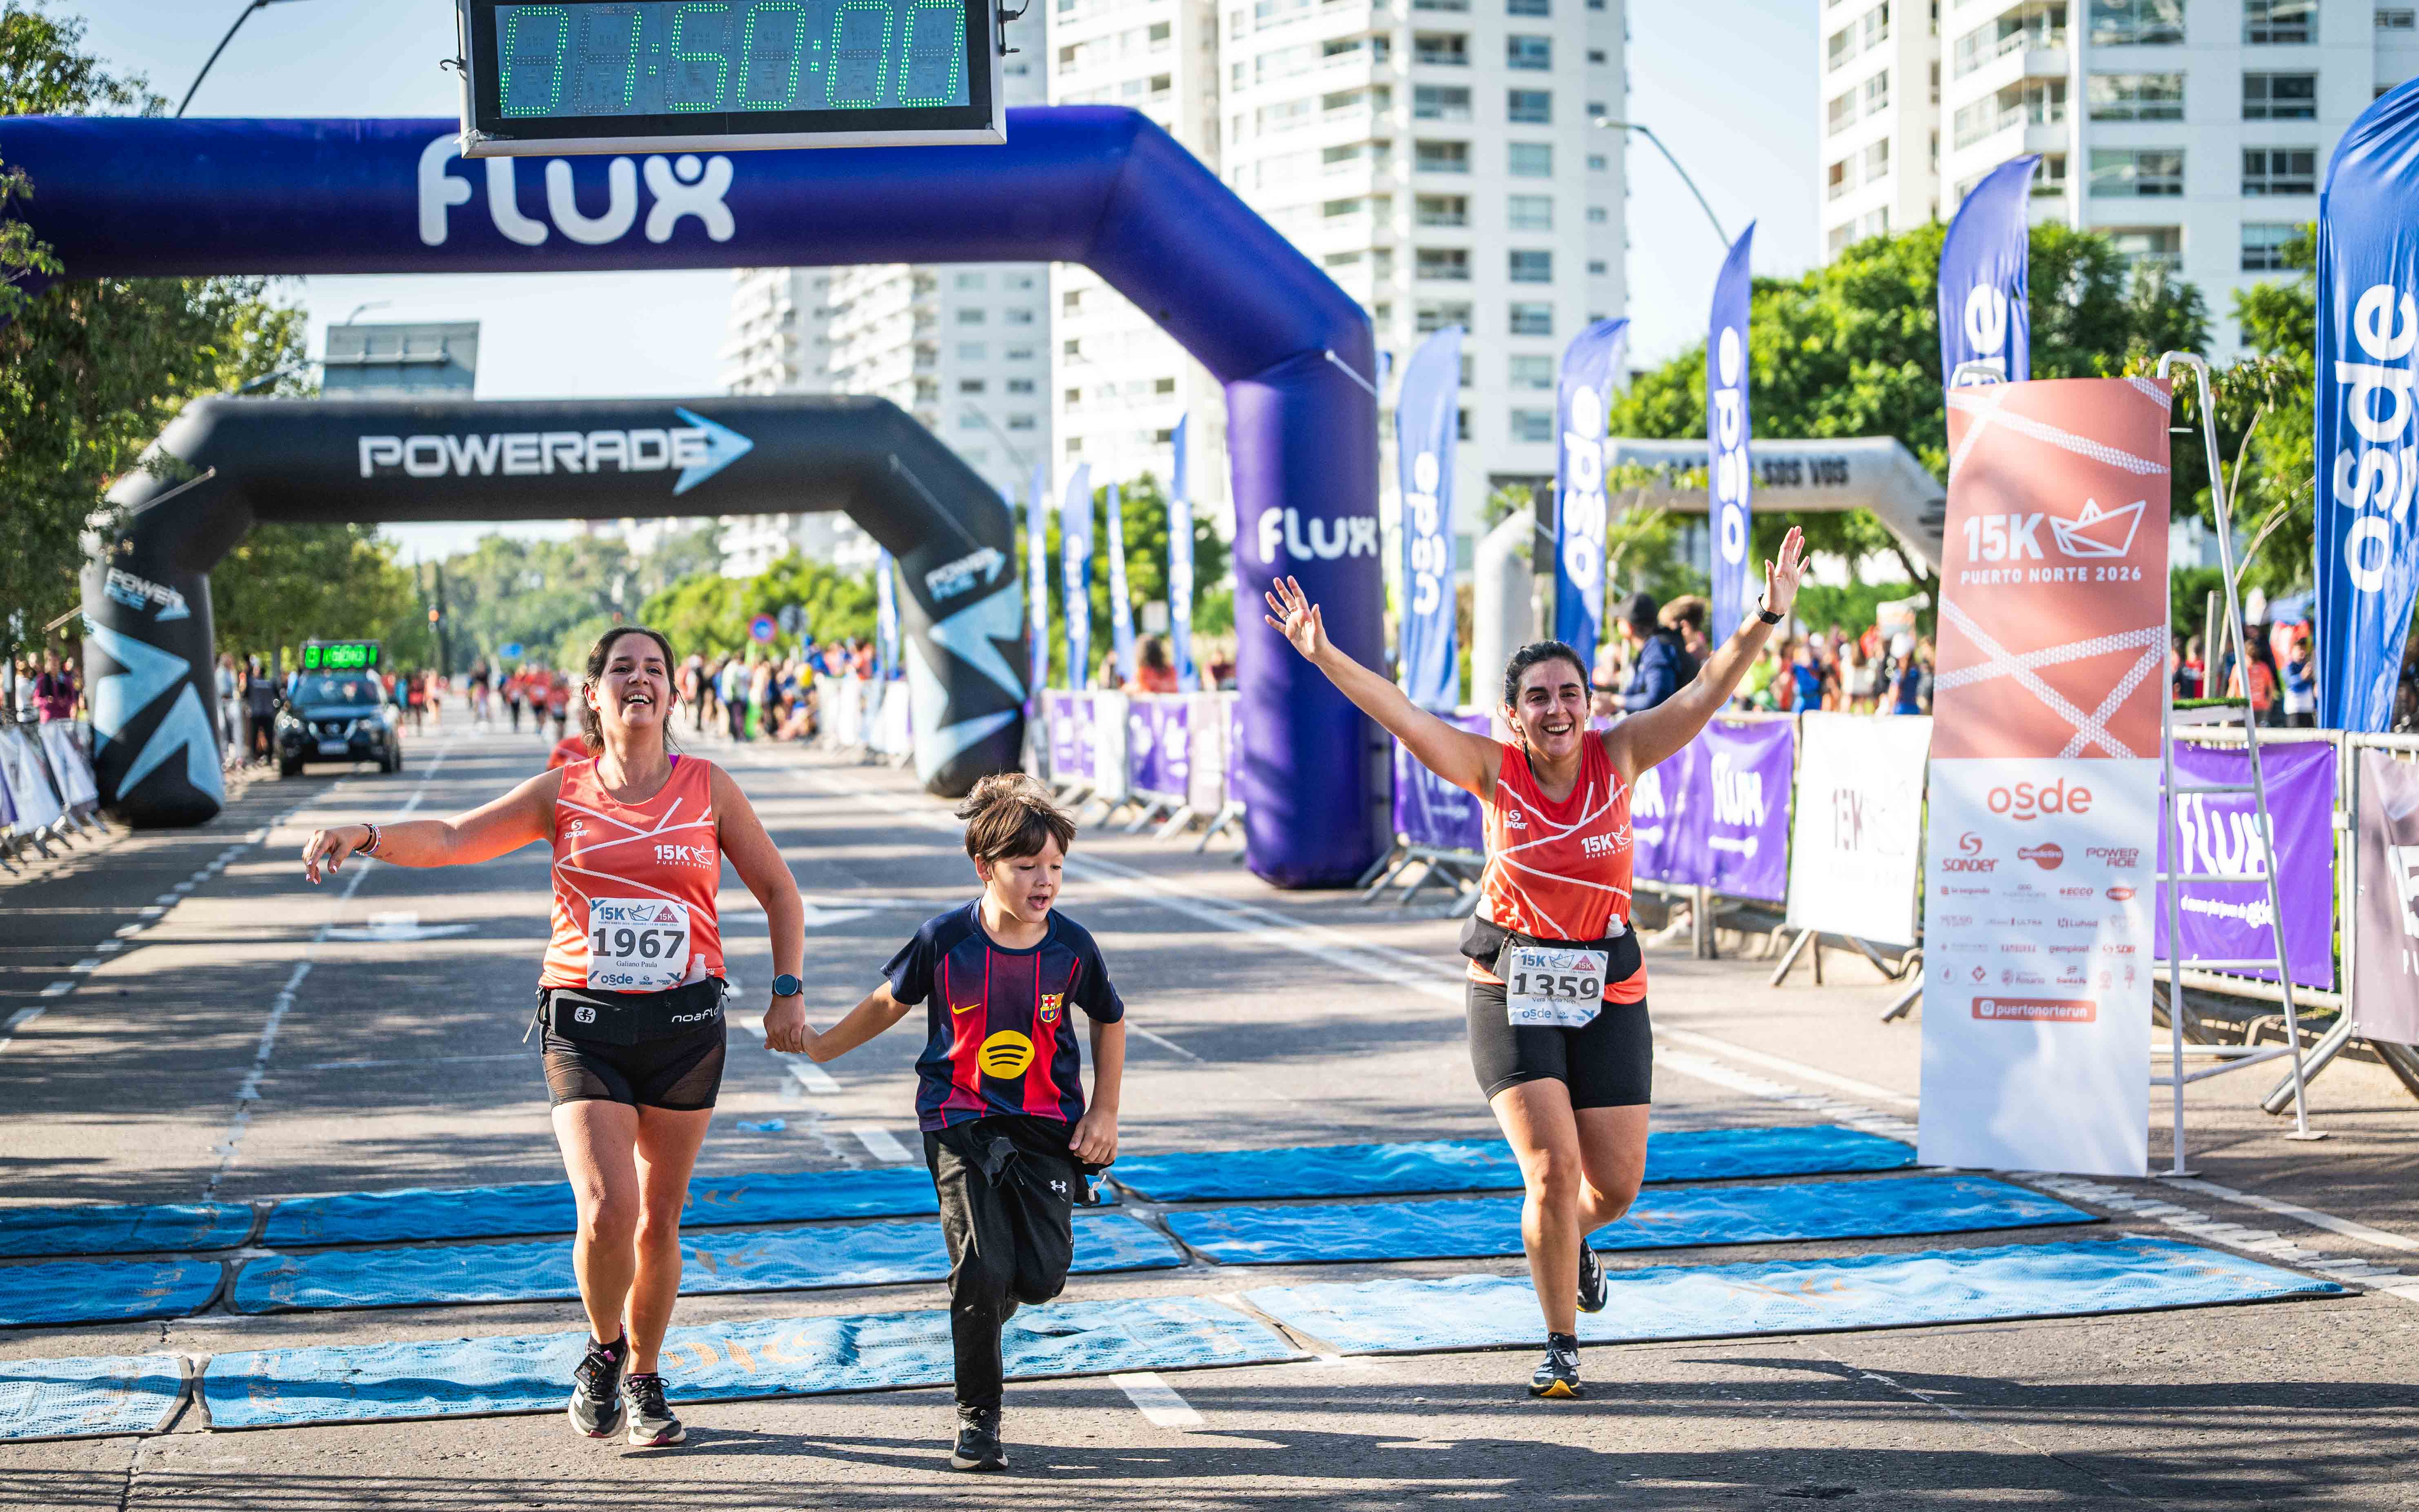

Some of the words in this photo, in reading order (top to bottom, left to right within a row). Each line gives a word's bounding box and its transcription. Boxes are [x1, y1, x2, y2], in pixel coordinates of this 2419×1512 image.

[1715, 326, 1748, 566] osde
[2333, 284, 2418, 593] osde
[358, 427, 710, 478] POWERADE
[1563, 385, 1607, 589] osde
[1964, 513, 2044, 562] 15K
[1960, 568, 2022, 585] PUERTO
[2029, 567, 2088, 582] NORTE
[2096, 565, 2142, 582] 2026
[1987, 777, 2092, 821] osde
[654, 845, 690, 860] 15K
[1581, 833, 1615, 853] 15K
[2086, 848, 2139, 857] POWER
[1586, 850, 1616, 859] PUERTO
[599, 907, 626, 920] 15K
[593, 928, 685, 959] 1967
[1521, 954, 1546, 967] 15K
[601, 973, 633, 986] osde
[1512, 973, 1599, 1000] 1359
[1522, 1008, 1552, 1019] osde
[1996, 1004, 2088, 1019] puertonorterun
